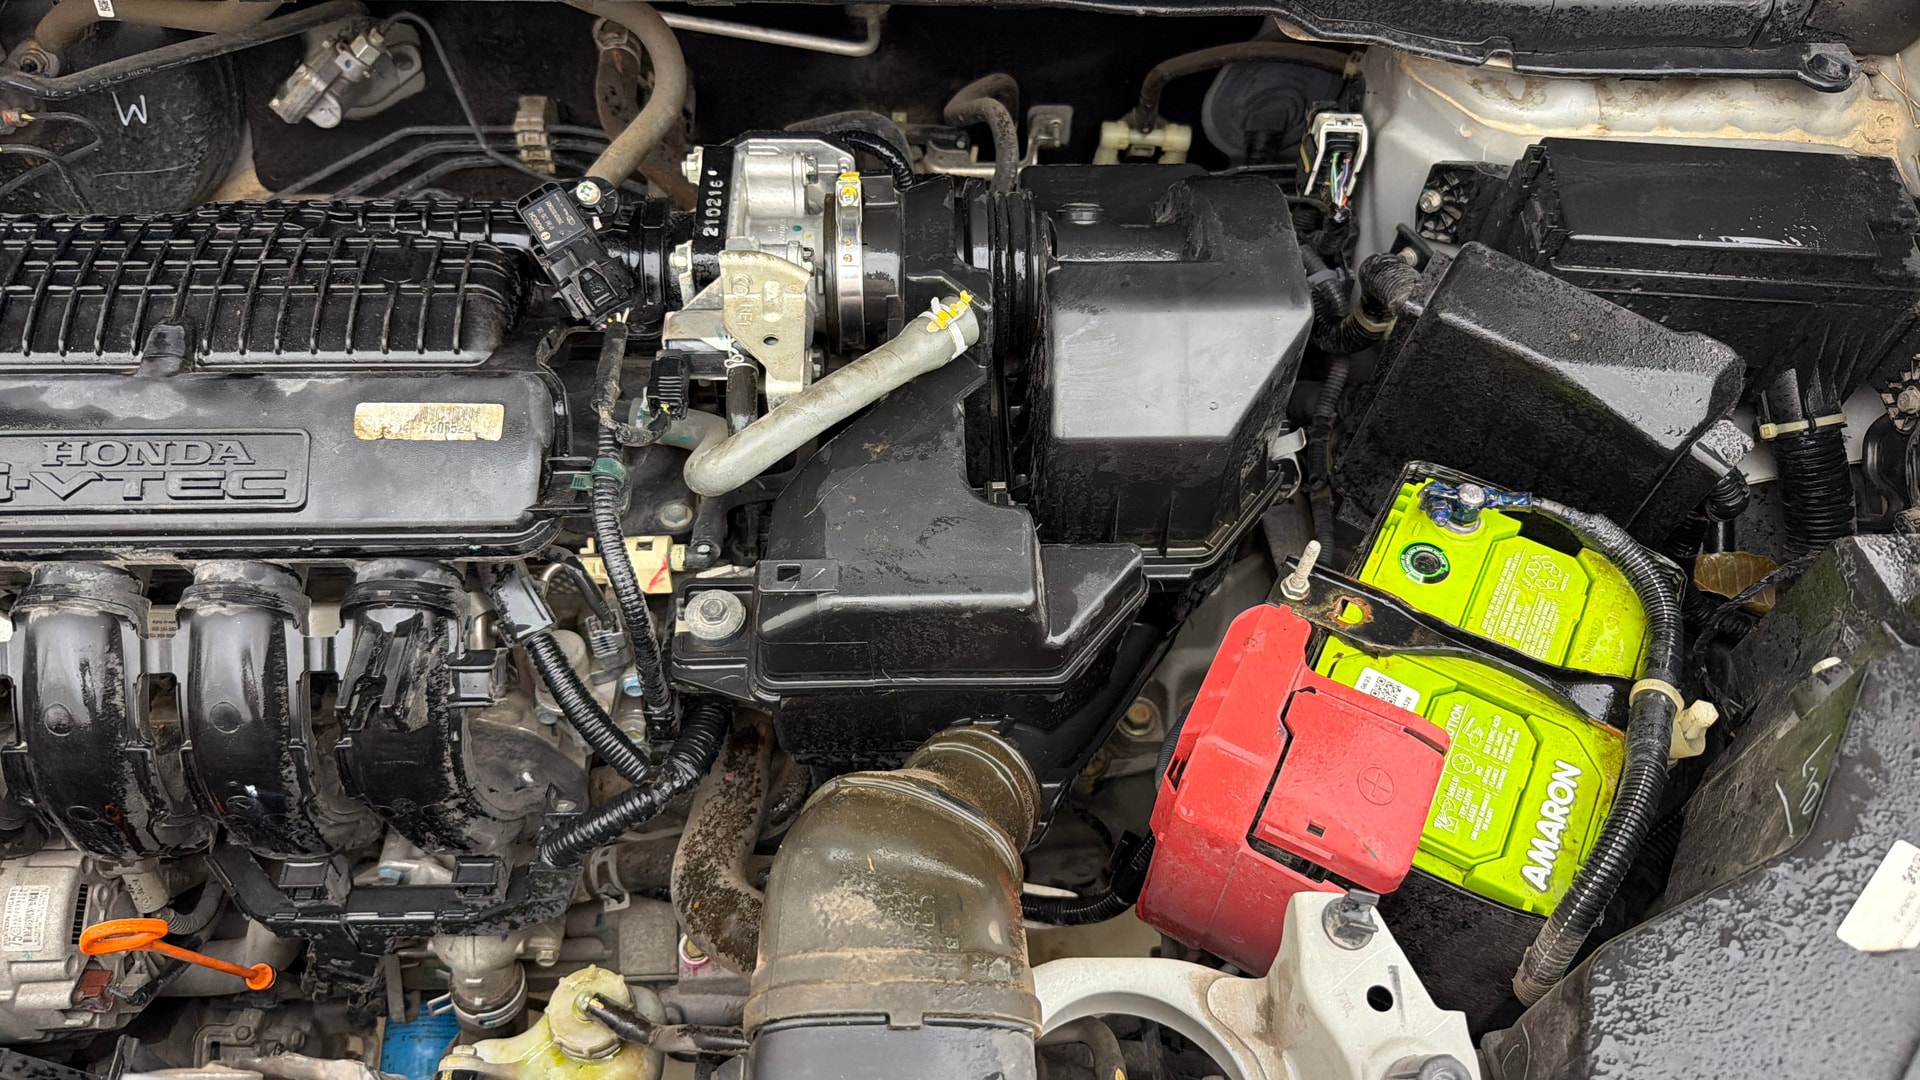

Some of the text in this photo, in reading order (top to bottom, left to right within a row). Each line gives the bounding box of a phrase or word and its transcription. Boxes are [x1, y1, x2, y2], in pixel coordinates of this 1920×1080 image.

[527, 210, 545, 231] BOSCH
[702, 180, 724, 236] 210216
[41, 439, 255, 466] HONDA
[1447, 703, 1464, 739] UTION
[1465, 802, 1479, 822] GASES
[1521, 759, 1582, 892] AMARON
